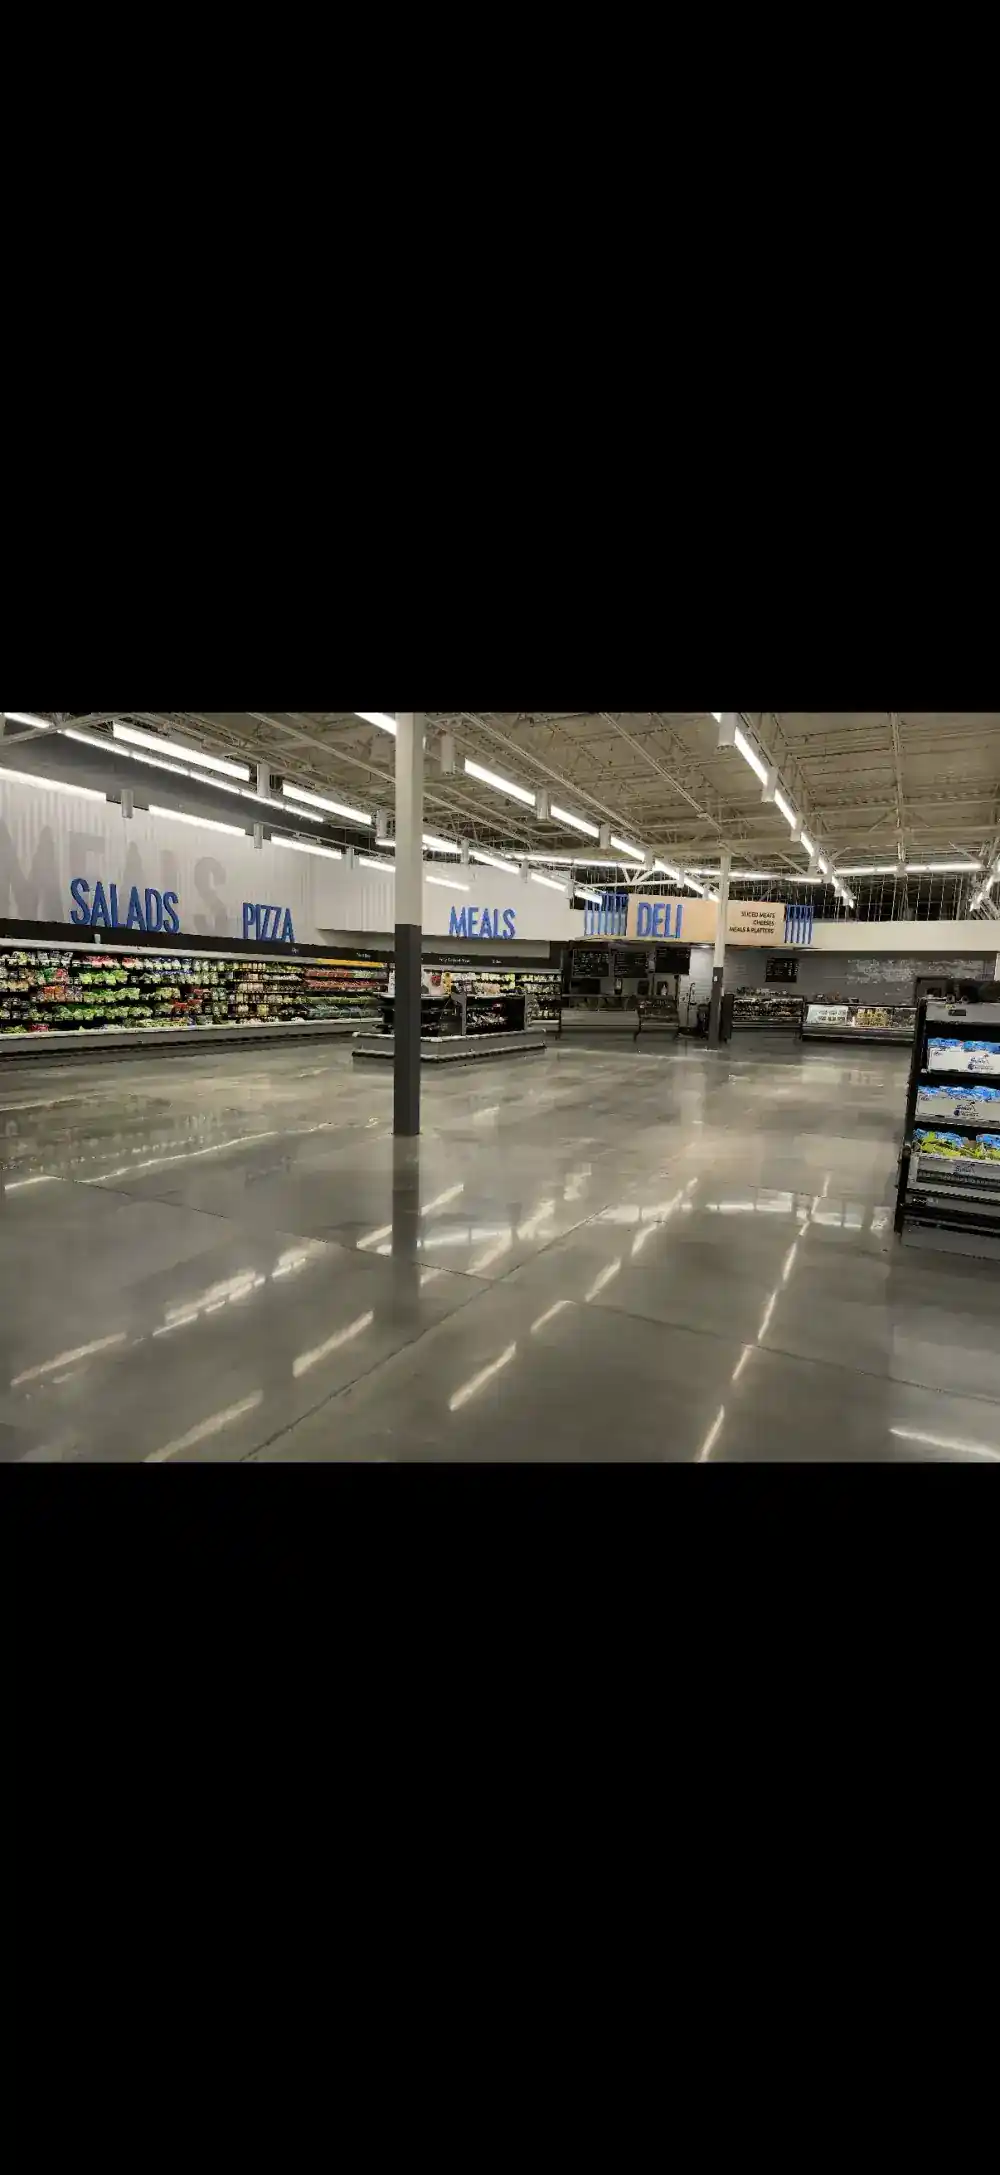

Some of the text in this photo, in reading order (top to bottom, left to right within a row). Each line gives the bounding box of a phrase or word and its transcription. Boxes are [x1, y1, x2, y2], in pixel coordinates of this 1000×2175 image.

[70, 878, 180, 933] SALADS
[242, 902, 295, 943] PIZZA
[449, 906, 516, 939] MEALS
[637, 903, 683, 938] DELI
